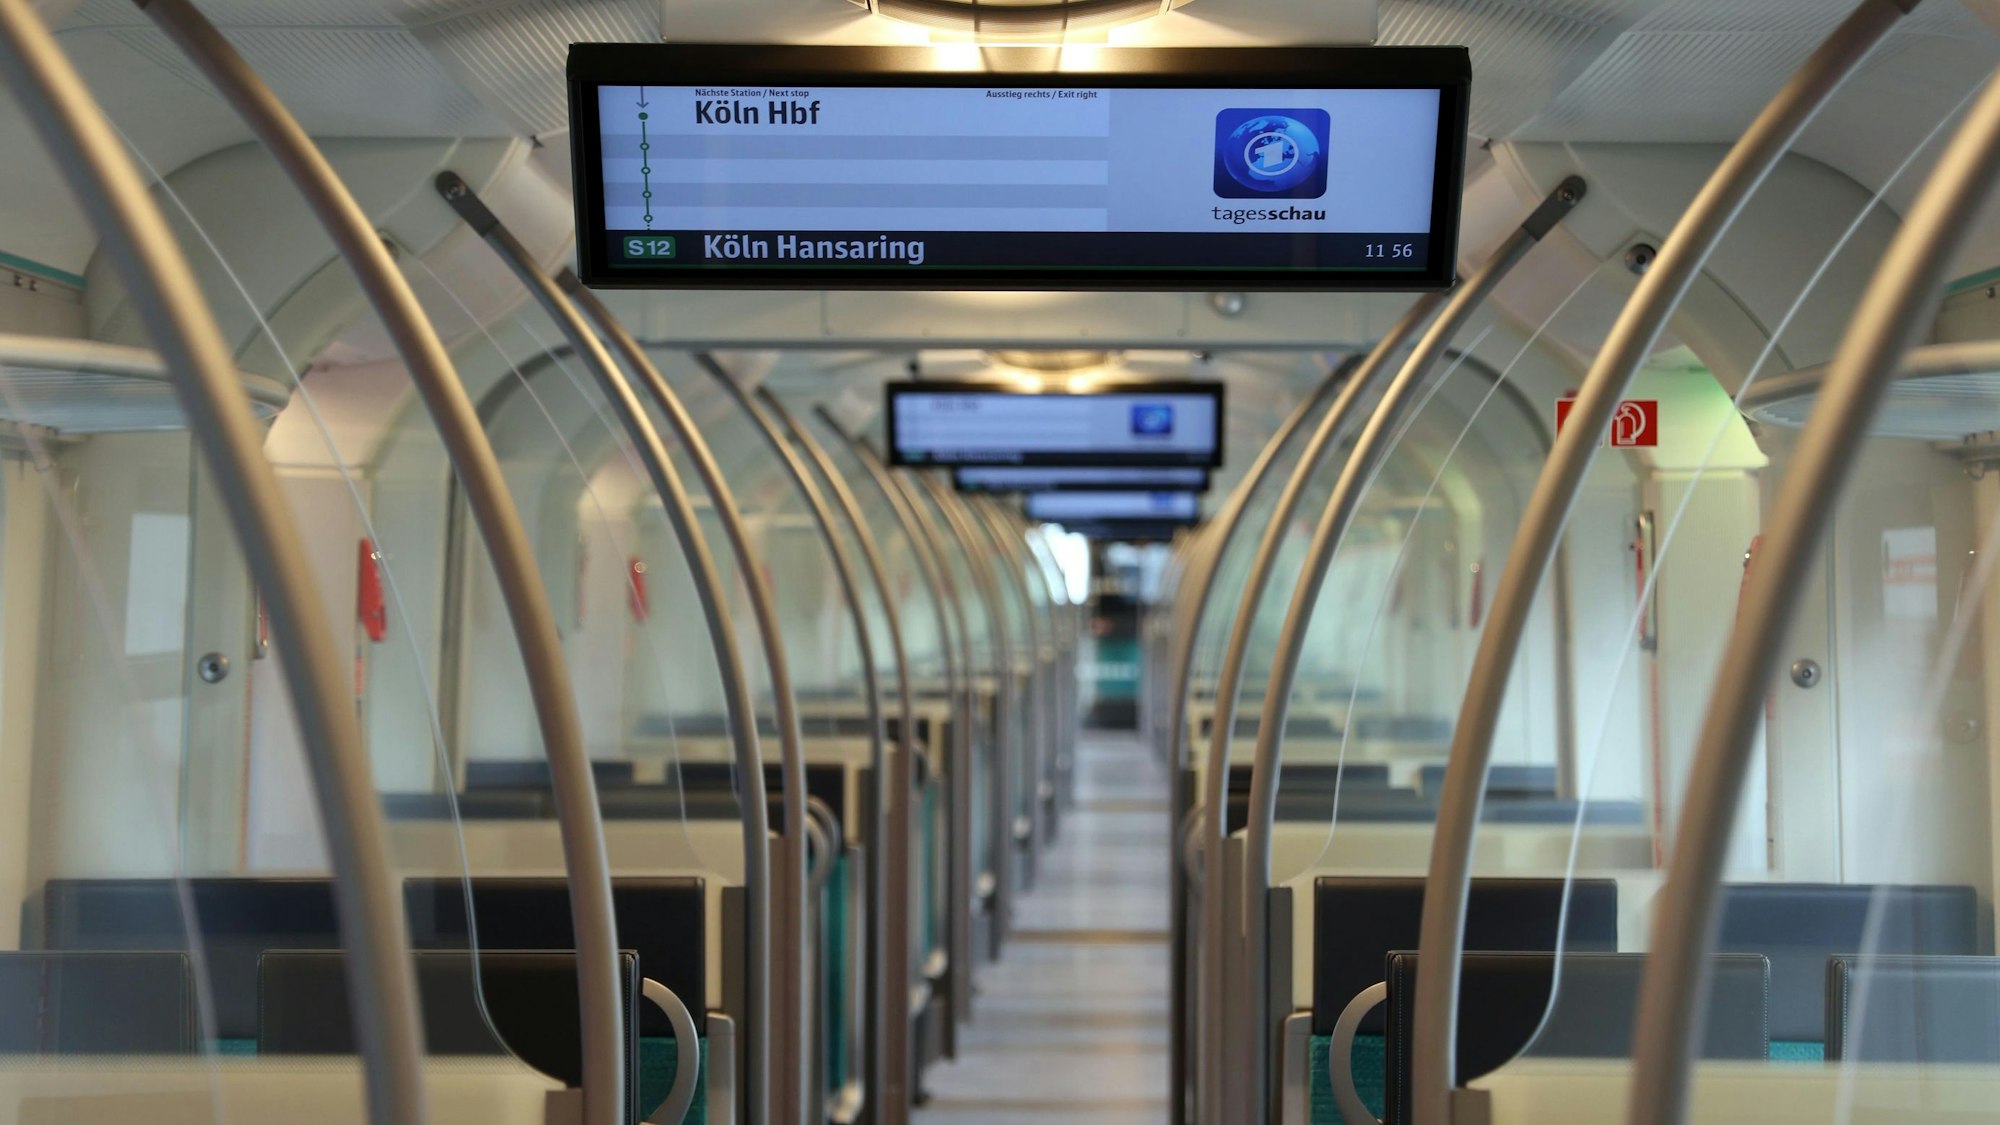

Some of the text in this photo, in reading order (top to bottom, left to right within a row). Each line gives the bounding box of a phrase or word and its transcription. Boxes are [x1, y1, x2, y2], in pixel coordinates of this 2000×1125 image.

[695, 88, 809, 98] Nächste Station / Next stop
[986, 90, 1022, 99] Ausstieg
[1024, 90, 1050, 98] rechts
[1076, 91, 1098, 99] right
[695, 100, 820, 125] Köln Hbf
[1212, 206, 1326, 224] tagesschau
[704, 234, 925, 265] Köln Hansaring
